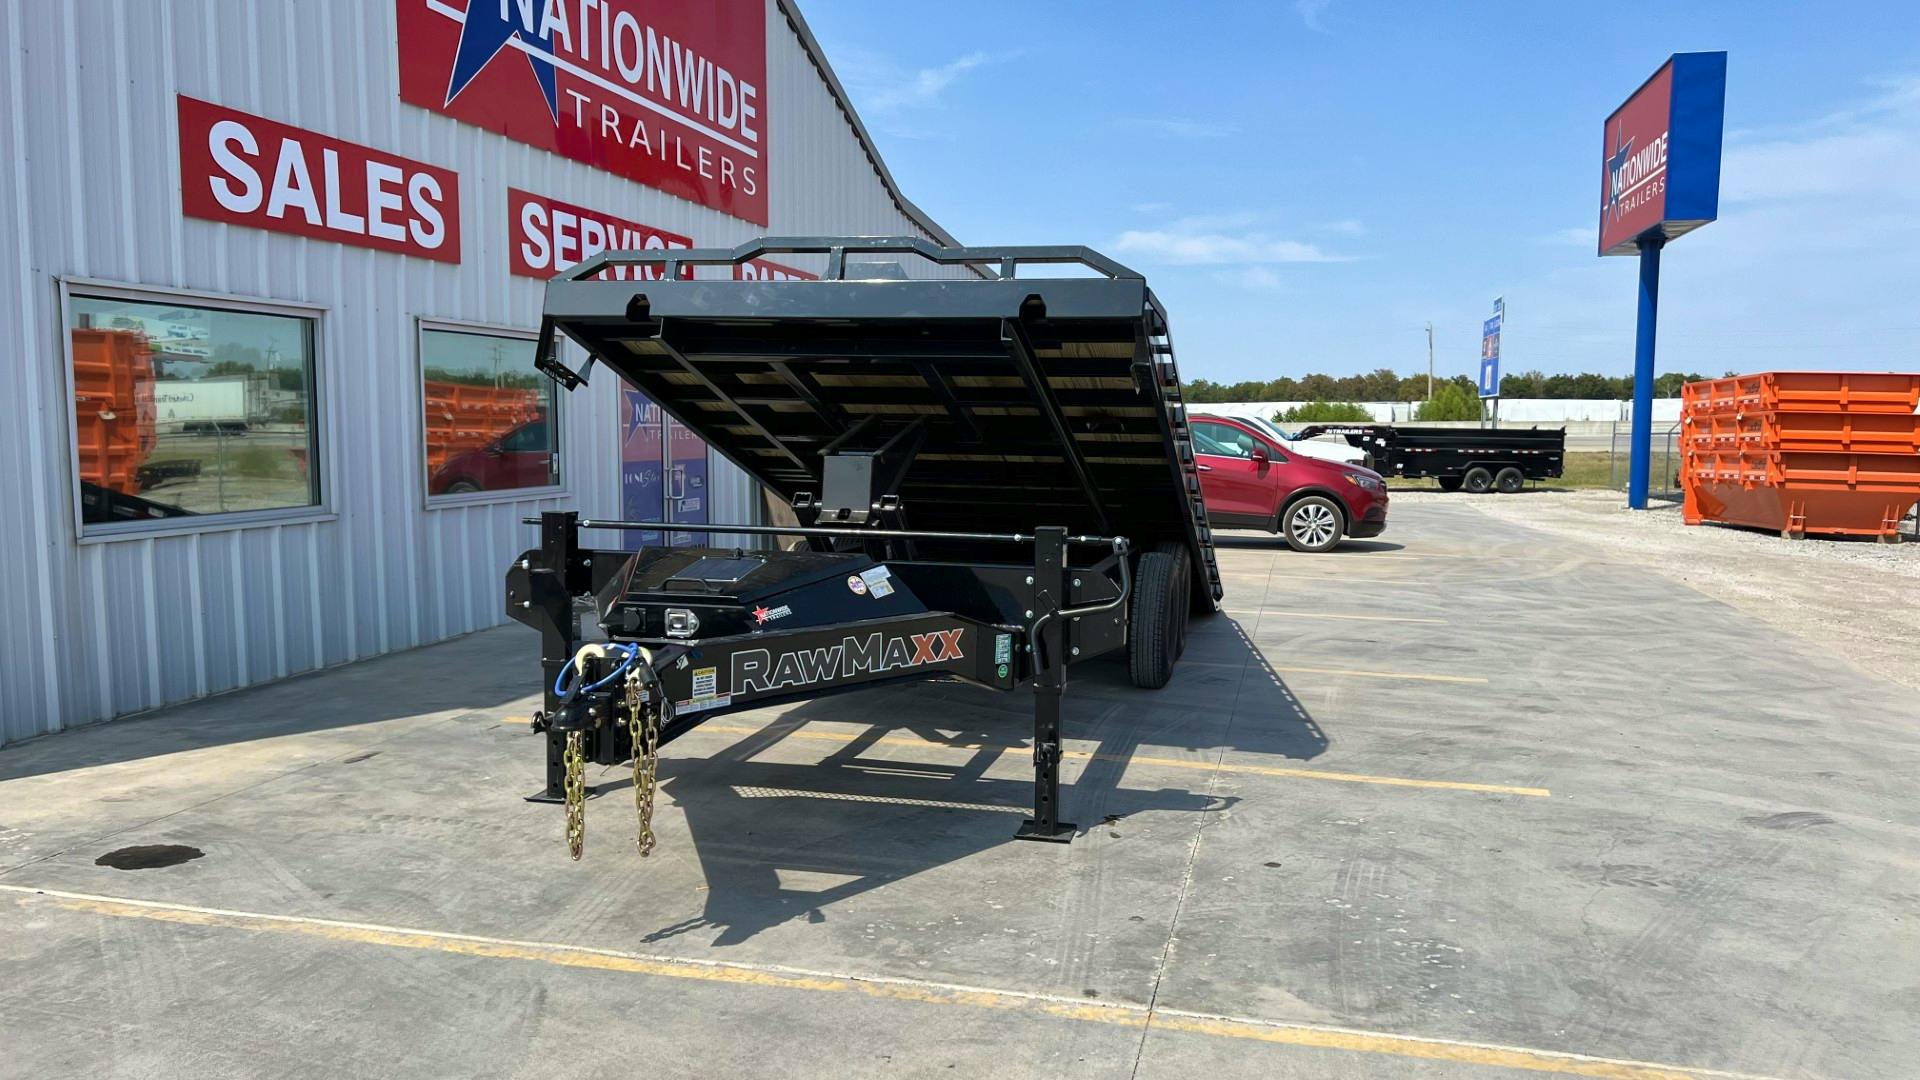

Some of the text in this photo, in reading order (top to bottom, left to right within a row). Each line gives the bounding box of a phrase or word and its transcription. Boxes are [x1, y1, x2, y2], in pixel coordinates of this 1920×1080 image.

[208, 120, 446, 249] SALES
[565, 88, 756, 196] TRAILERS
[1611, 131, 1668, 198] NATIONWIDE
[1620, 176, 1665, 217] TRAILERS
